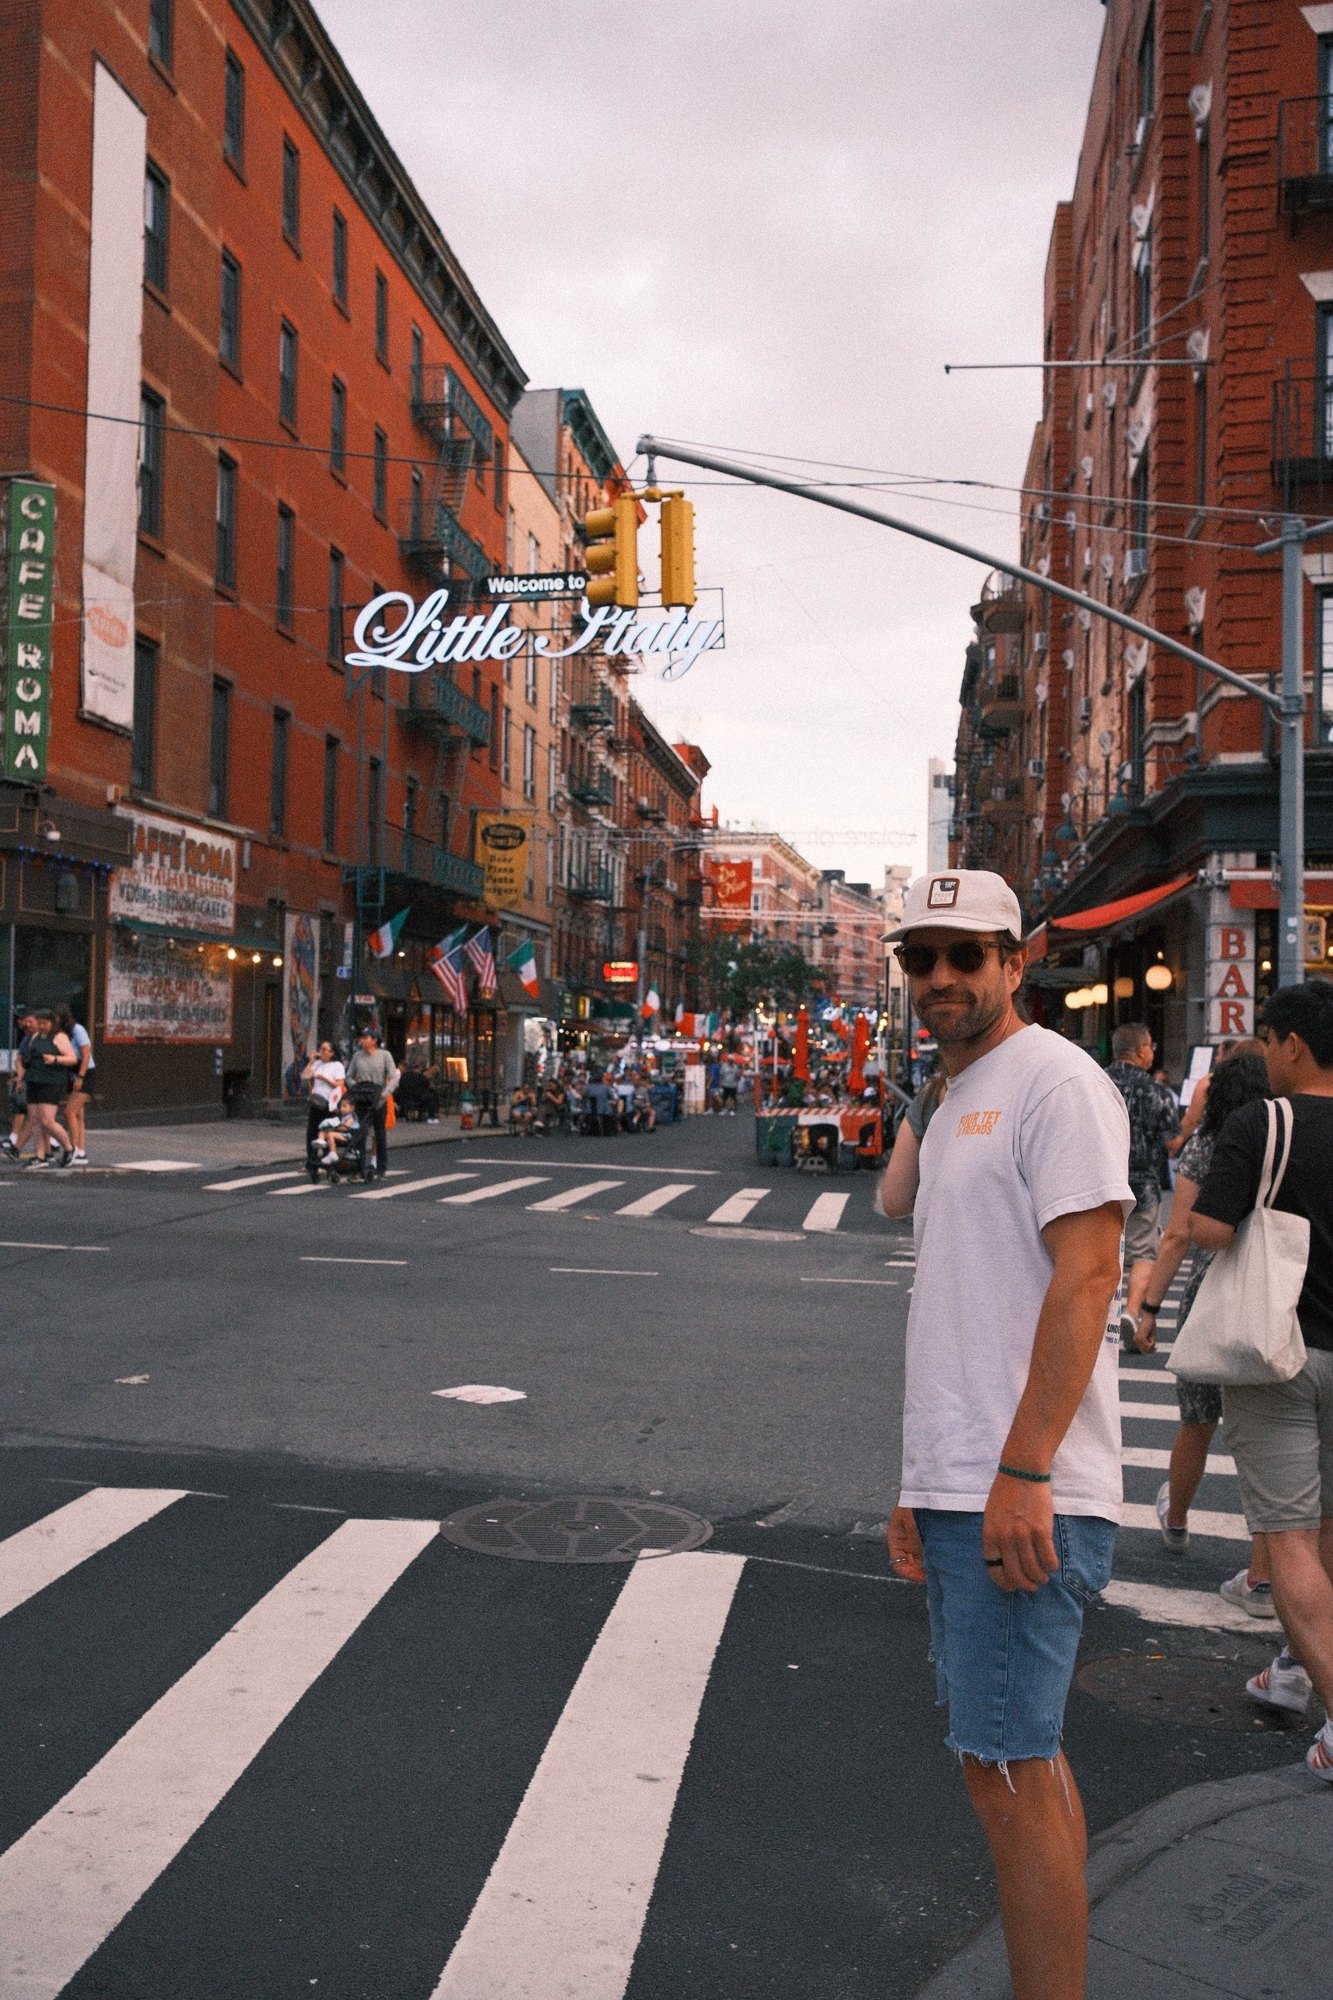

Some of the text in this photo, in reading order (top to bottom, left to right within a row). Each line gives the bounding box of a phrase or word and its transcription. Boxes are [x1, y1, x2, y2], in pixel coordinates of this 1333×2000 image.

[487, 575, 585, 594] Welcome to
[14, 494, 46, 770] CAFE ROMA
[344, 588, 725, 682] Little Italy
[185, 838, 233, 882] ROMA
[1217, 928, 1247, 1034] BAR
[982, 1110, 1002, 1125] TET
